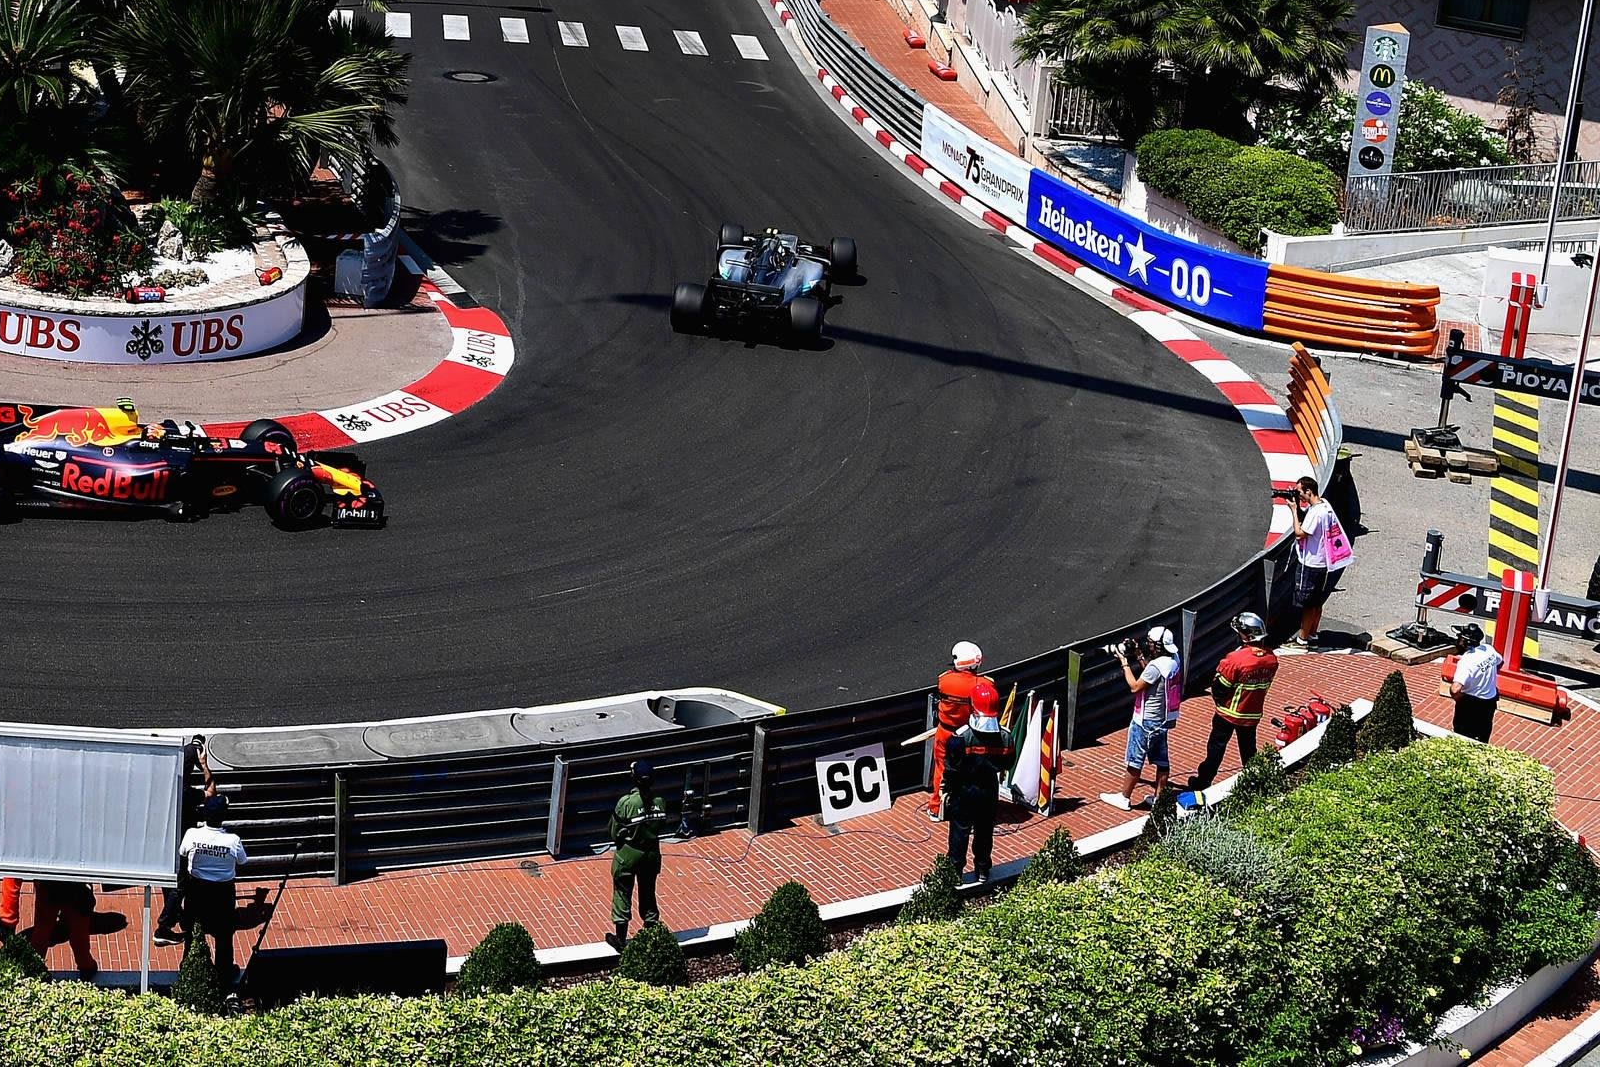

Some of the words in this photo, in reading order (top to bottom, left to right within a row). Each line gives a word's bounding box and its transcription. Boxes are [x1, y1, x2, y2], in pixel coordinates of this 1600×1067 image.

[942, 140, 967, 169] MONACO
[1038, 194, 1123, 266] Heineken
[171, 314, 245, 357] UBS
[466, 330, 496, 356] UBS
[361, 396, 431, 424] UBS
[22, 446, 54, 459] Heuer
[337, 508, 367, 520] Mobil
[826, 755, 881, 810] SC
[195, 848, 227, 859] CIRCUIT
